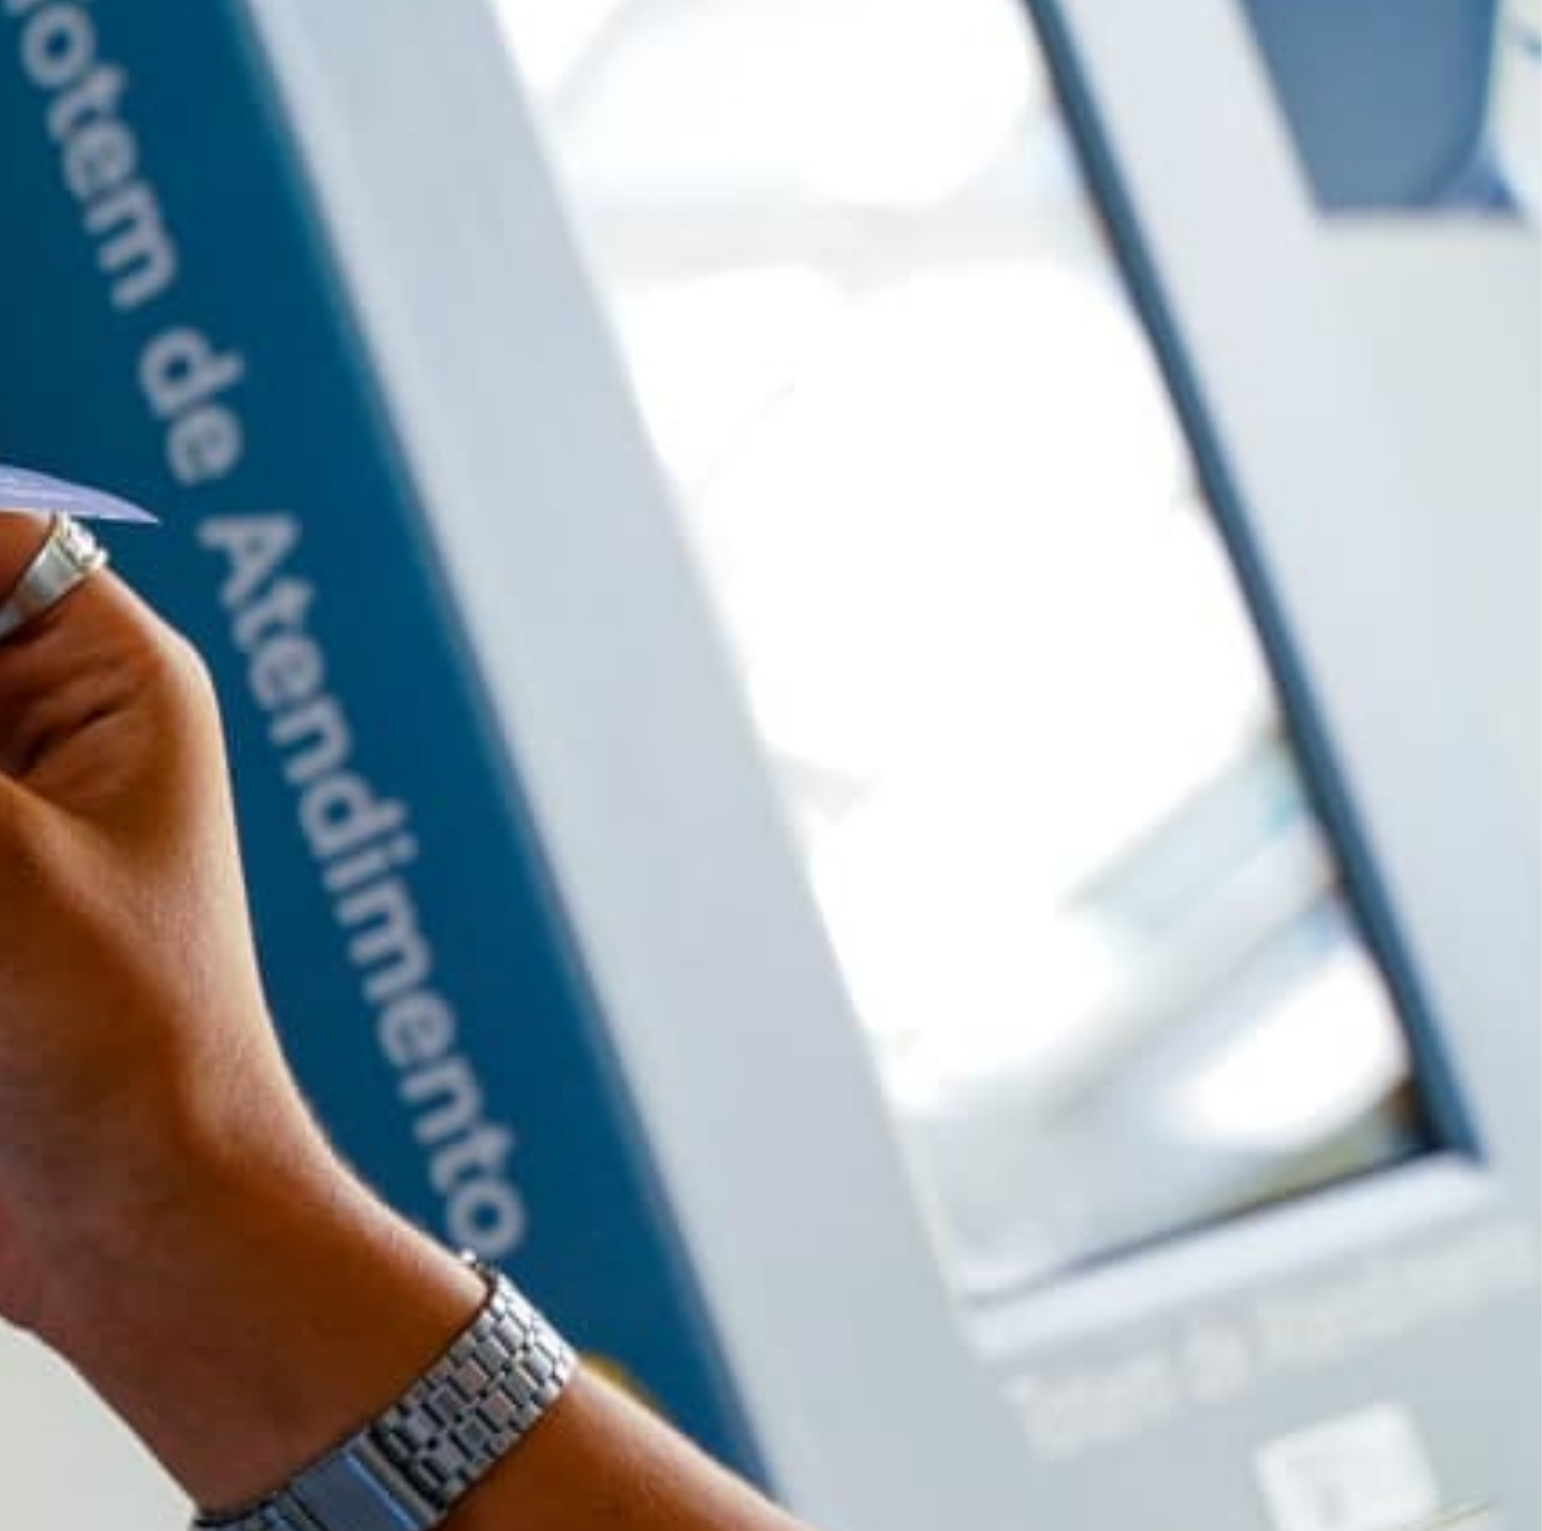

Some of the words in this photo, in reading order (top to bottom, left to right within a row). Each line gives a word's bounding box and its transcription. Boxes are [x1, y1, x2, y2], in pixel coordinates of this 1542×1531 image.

[3, 0, 179, 308] otem
[138, 327, 244, 485] de
[198, 512, 525, 1257] Atendimento
